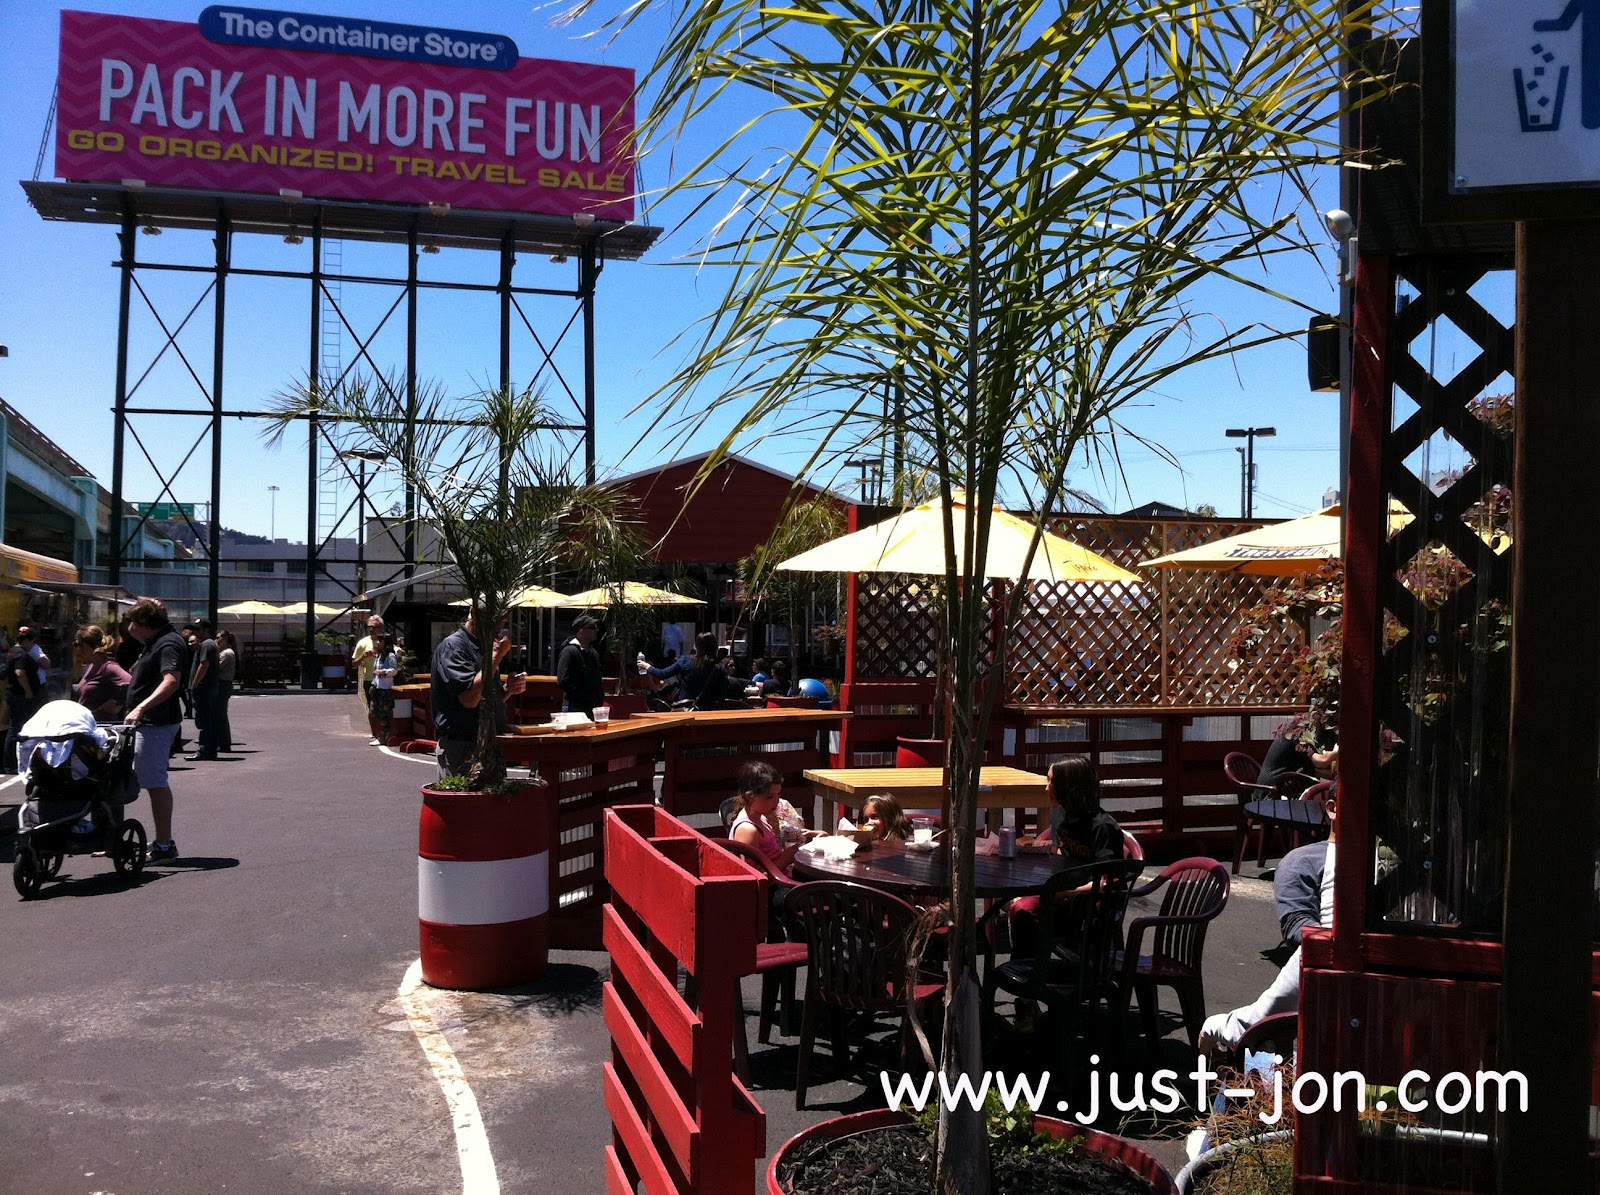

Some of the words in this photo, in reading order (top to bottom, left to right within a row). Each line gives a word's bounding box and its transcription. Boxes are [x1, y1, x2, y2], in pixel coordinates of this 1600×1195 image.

[219, 11, 274, 39] The
[278, 17, 420, 53] Container
[99, 58, 245, 134] PACK
[264, 74, 317, 139] IN
[338, 81, 487, 154] MORE
[505, 97, 601, 164] FUN
[67, 130, 125, 152] GO
[139, 135, 374, 173] ORGANIZED!
[388, 155, 526, 185] TRAVEL
[537, 168, 626, 193] SALE
